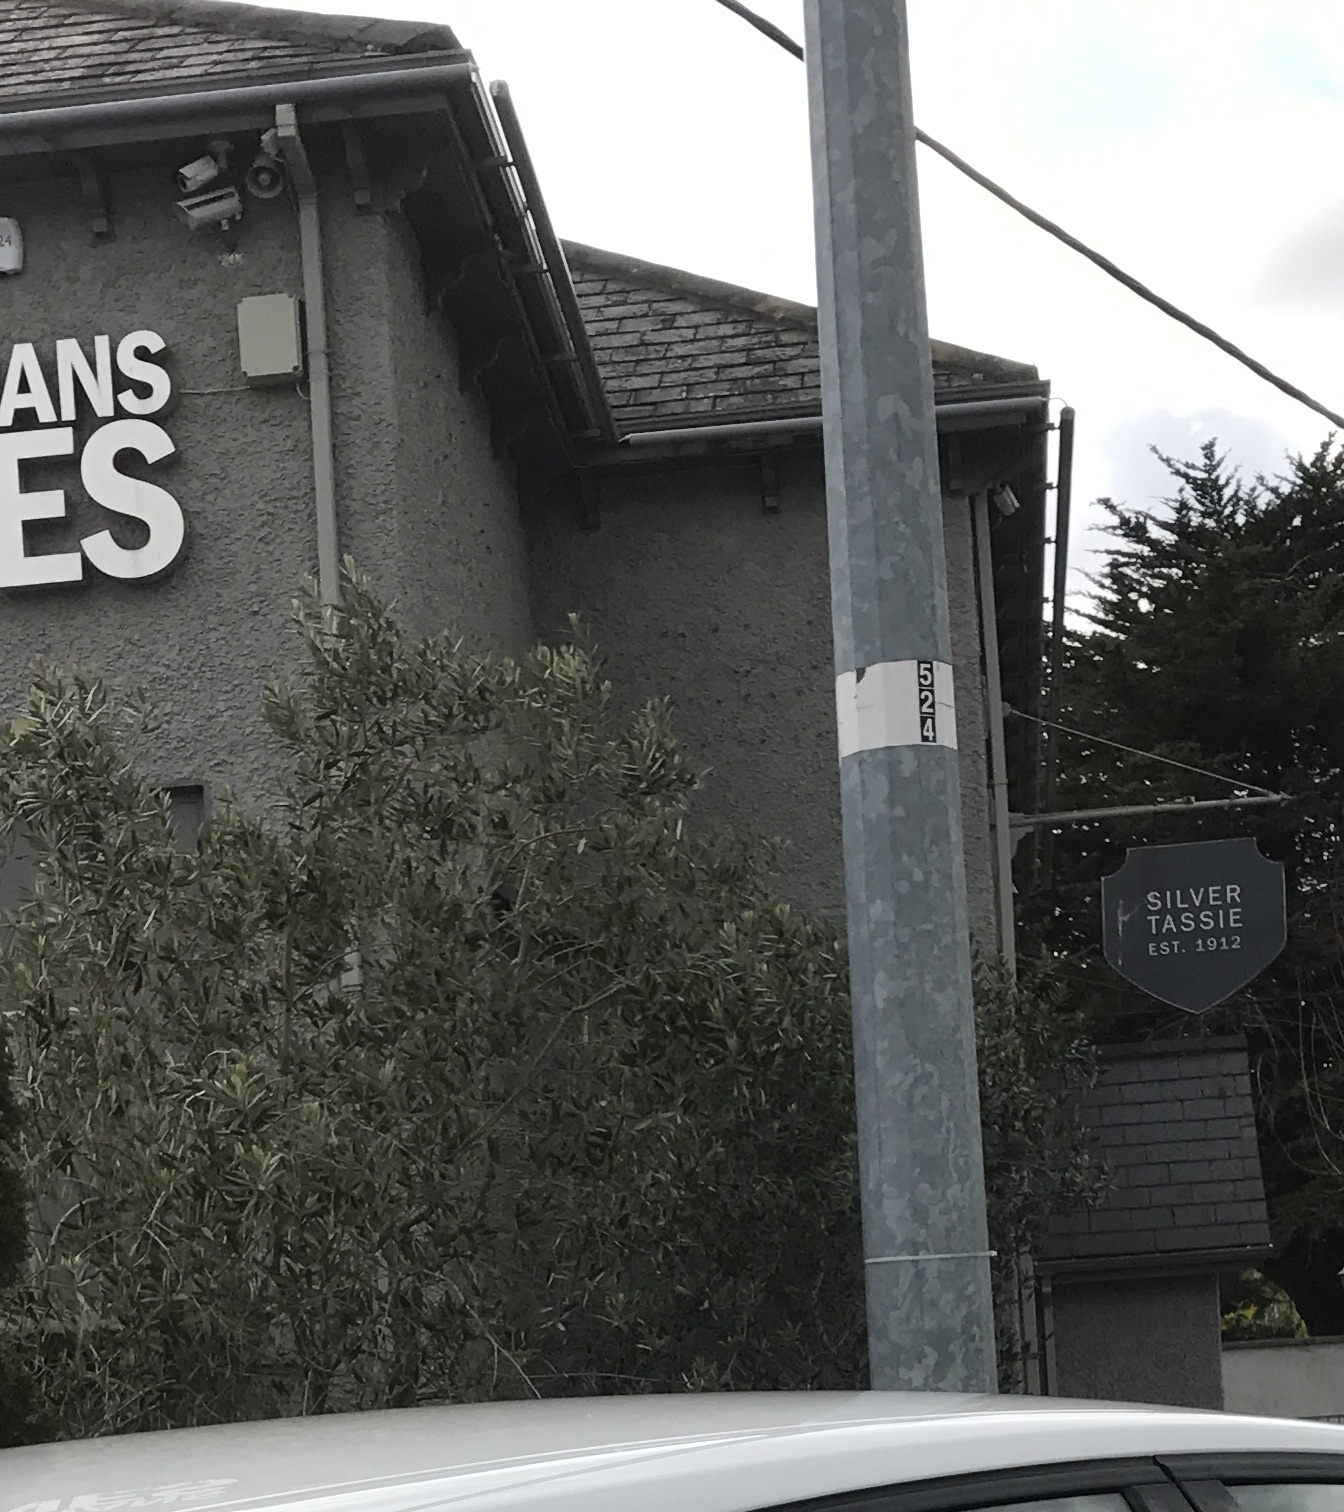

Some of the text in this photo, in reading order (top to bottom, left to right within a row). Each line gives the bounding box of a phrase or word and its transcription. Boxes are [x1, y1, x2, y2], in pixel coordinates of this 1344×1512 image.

[919, 663, 935, 742] 524
[1146, 884, 1242, 911] SILVER
[1146, 908, 1243, 935] TASSIE
[1148, 935, 1242, 956] EST. 1912
